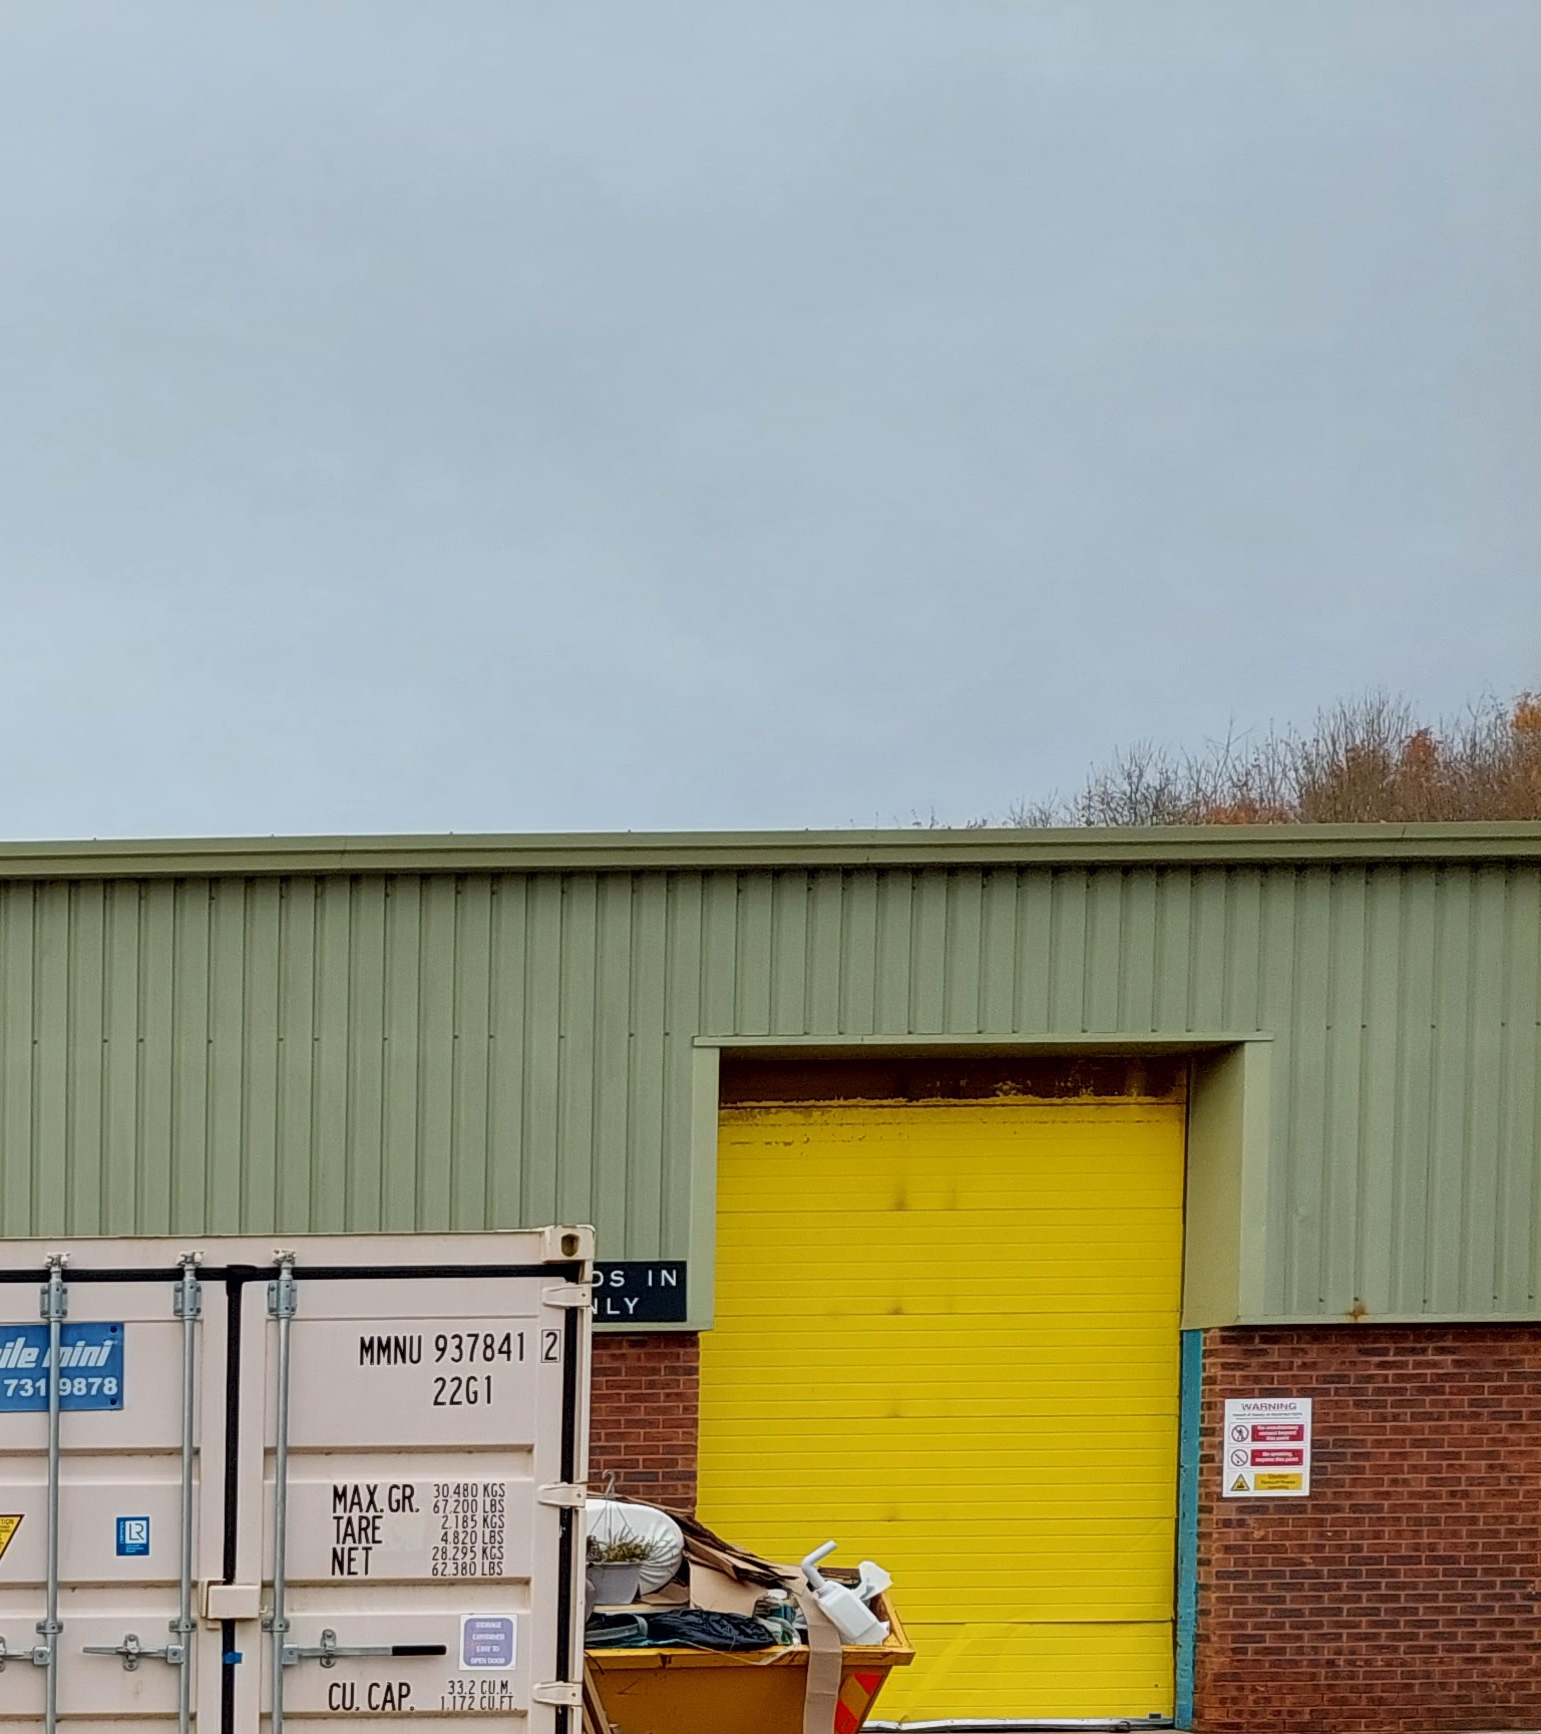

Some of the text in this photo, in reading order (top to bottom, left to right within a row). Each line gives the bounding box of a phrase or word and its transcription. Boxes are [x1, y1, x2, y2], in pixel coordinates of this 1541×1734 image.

[648, 1270, 676, 1286] IN
[41, 1340, 113, 1368] mini
[359, 1332, 557, 1366] MMNU 937841 2
[4, 1378, 46, 1396] 731
[59, 1377, 117, 1396] 9878
[433, 1376, 491, 1406] 22G1
[1241, 1402, 1297, 1410] WARNING
[433, 1484, 505, 1498] 30.480 KGS
[433, 1499, 505, 1514] 67.200 LBS
[333, 1515, 383, 1544] TARE
[441, 1514, 505, 1530] 2.185 KGS
[441, 1530, 504, 1544] 4.820 LBS
[332, 1547, 373, 1576] NET
[432, 1546, 504, 1561] 28.295 KGS
[432, 1562, 503, 1576] 62.380 LBS
[447, 1680, 475, 1694] 33.2
[367, 1682, 415, 1711] CAP.
[441, 1696, 475, 1710] 1.172
